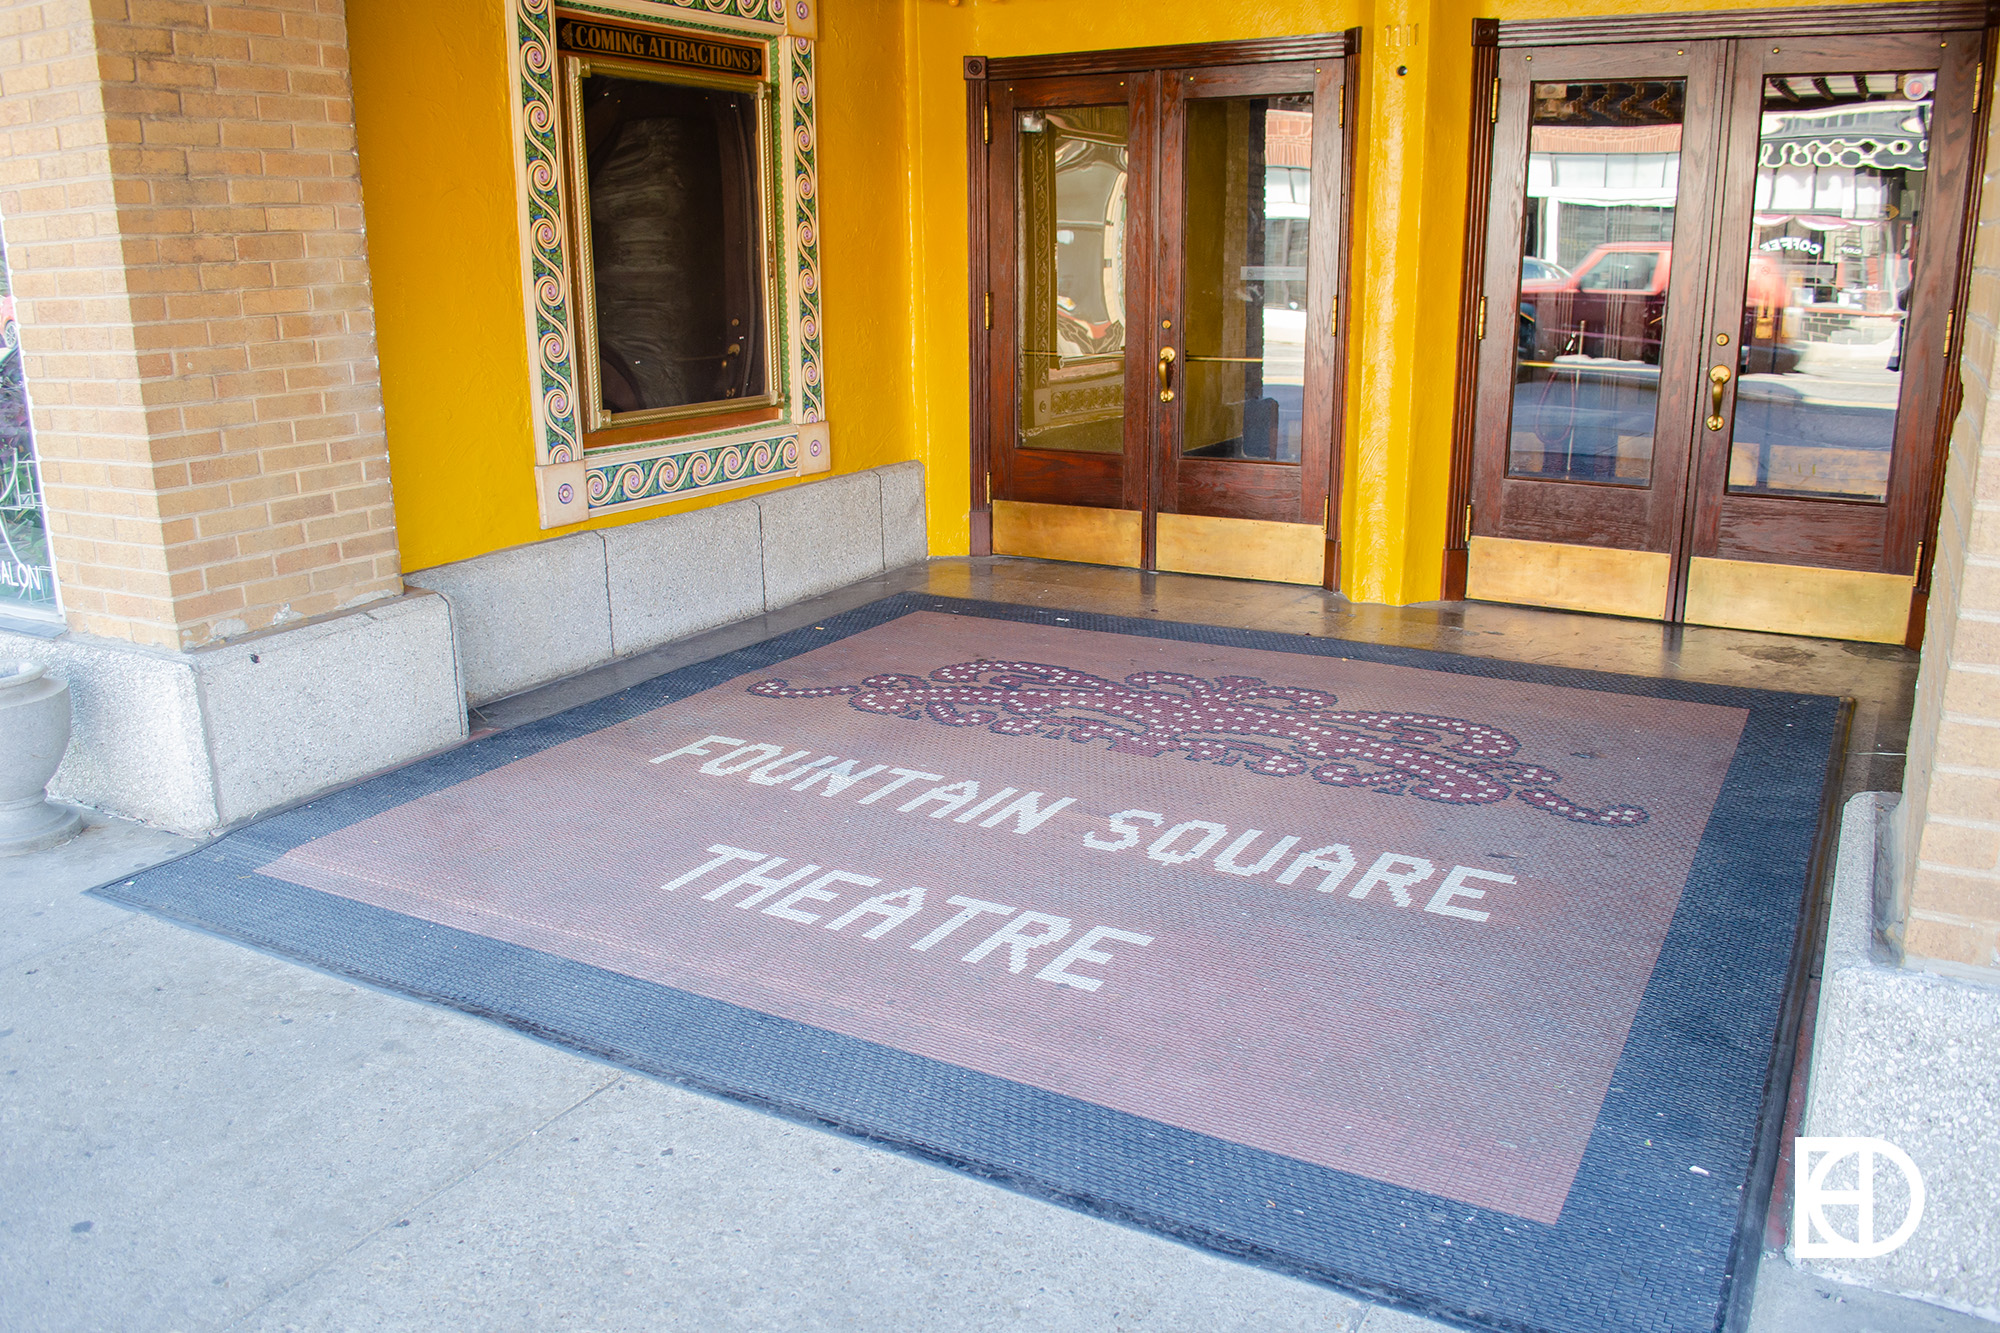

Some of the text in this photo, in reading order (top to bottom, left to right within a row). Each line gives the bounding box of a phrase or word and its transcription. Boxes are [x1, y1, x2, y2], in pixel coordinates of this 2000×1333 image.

[575, 25, 751, 69] COMING ATTRACTIONS
[0, 560, 41, 591] ALON
[648, 734, 1518, 923] FOUNTAIN SQUARE
[660, 843, 1156, 993] THEATRE
